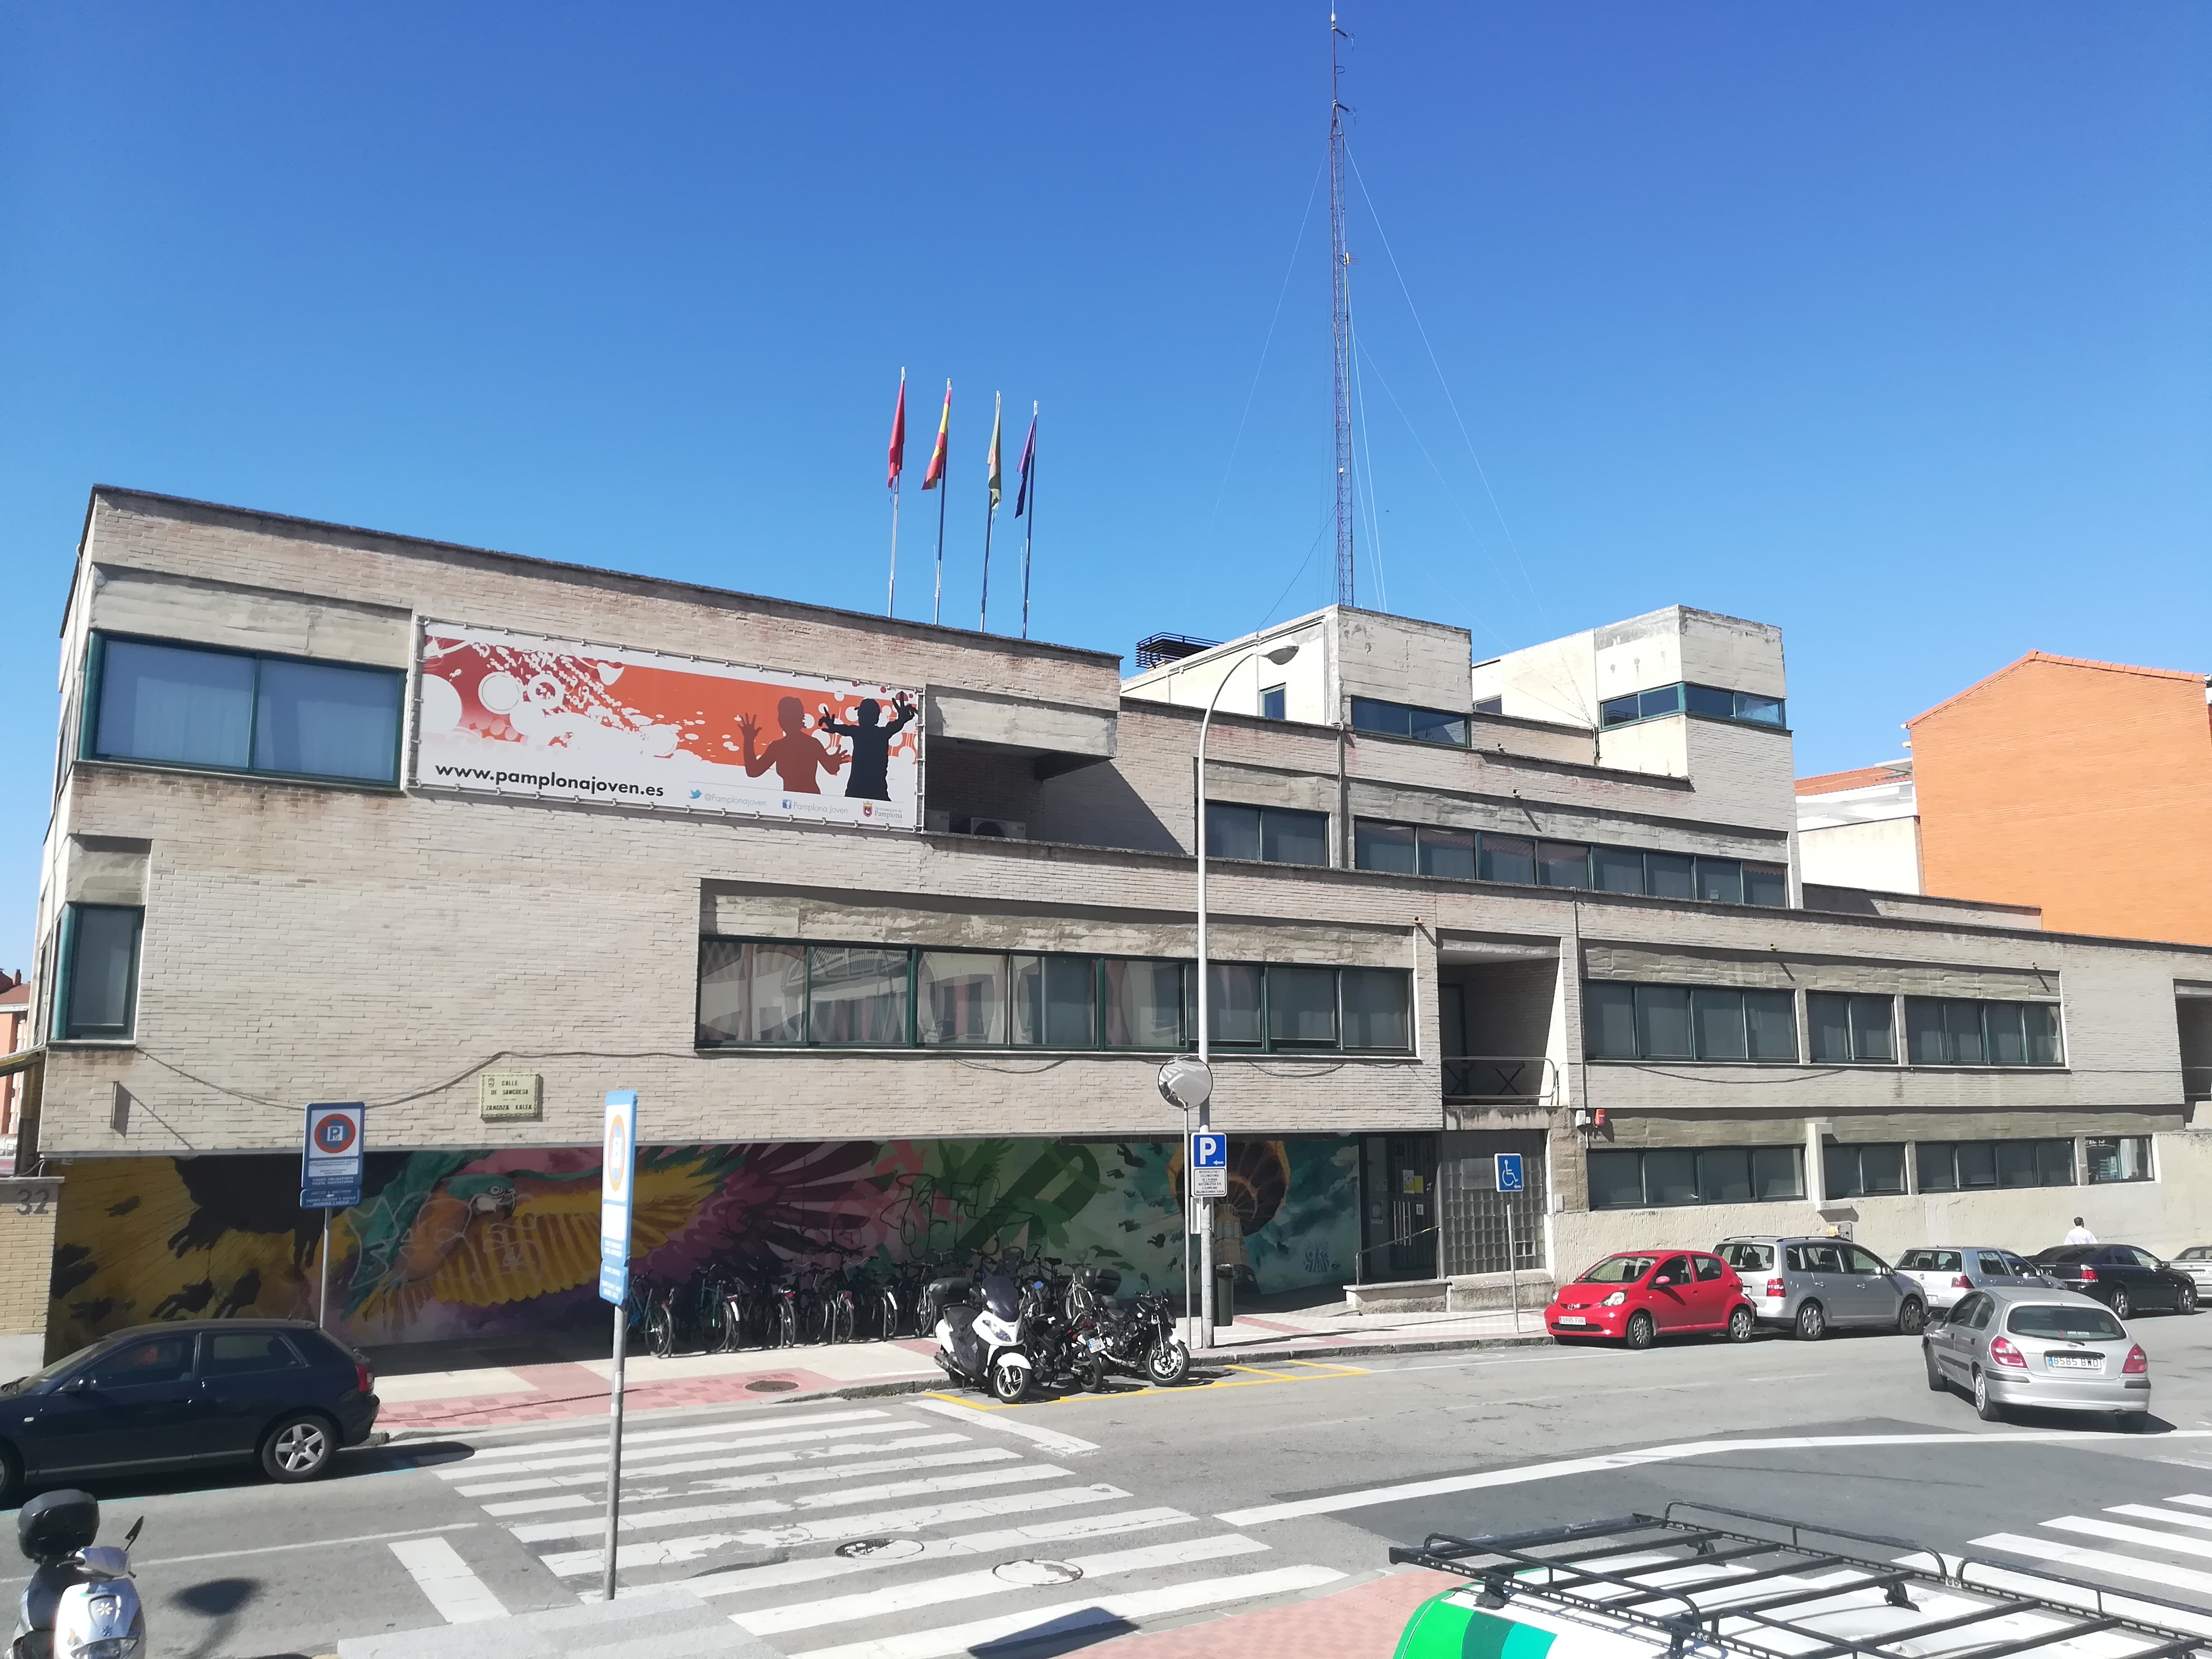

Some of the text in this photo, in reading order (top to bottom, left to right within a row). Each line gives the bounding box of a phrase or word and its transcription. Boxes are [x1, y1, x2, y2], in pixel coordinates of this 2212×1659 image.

[435, 765, 664, 796] www.pamplonajoven.es
[704, 793, 767, 807] @Pamplonajoven
[793, 802, 828, 812] Pamplona
[875, 810, 903, 818] Pamplona
[1200, 1137, 1216, 1165] P
[17, 1189, 49, 1215] 32
[2054, 1357, 2099, 1367] 8585 BWD
